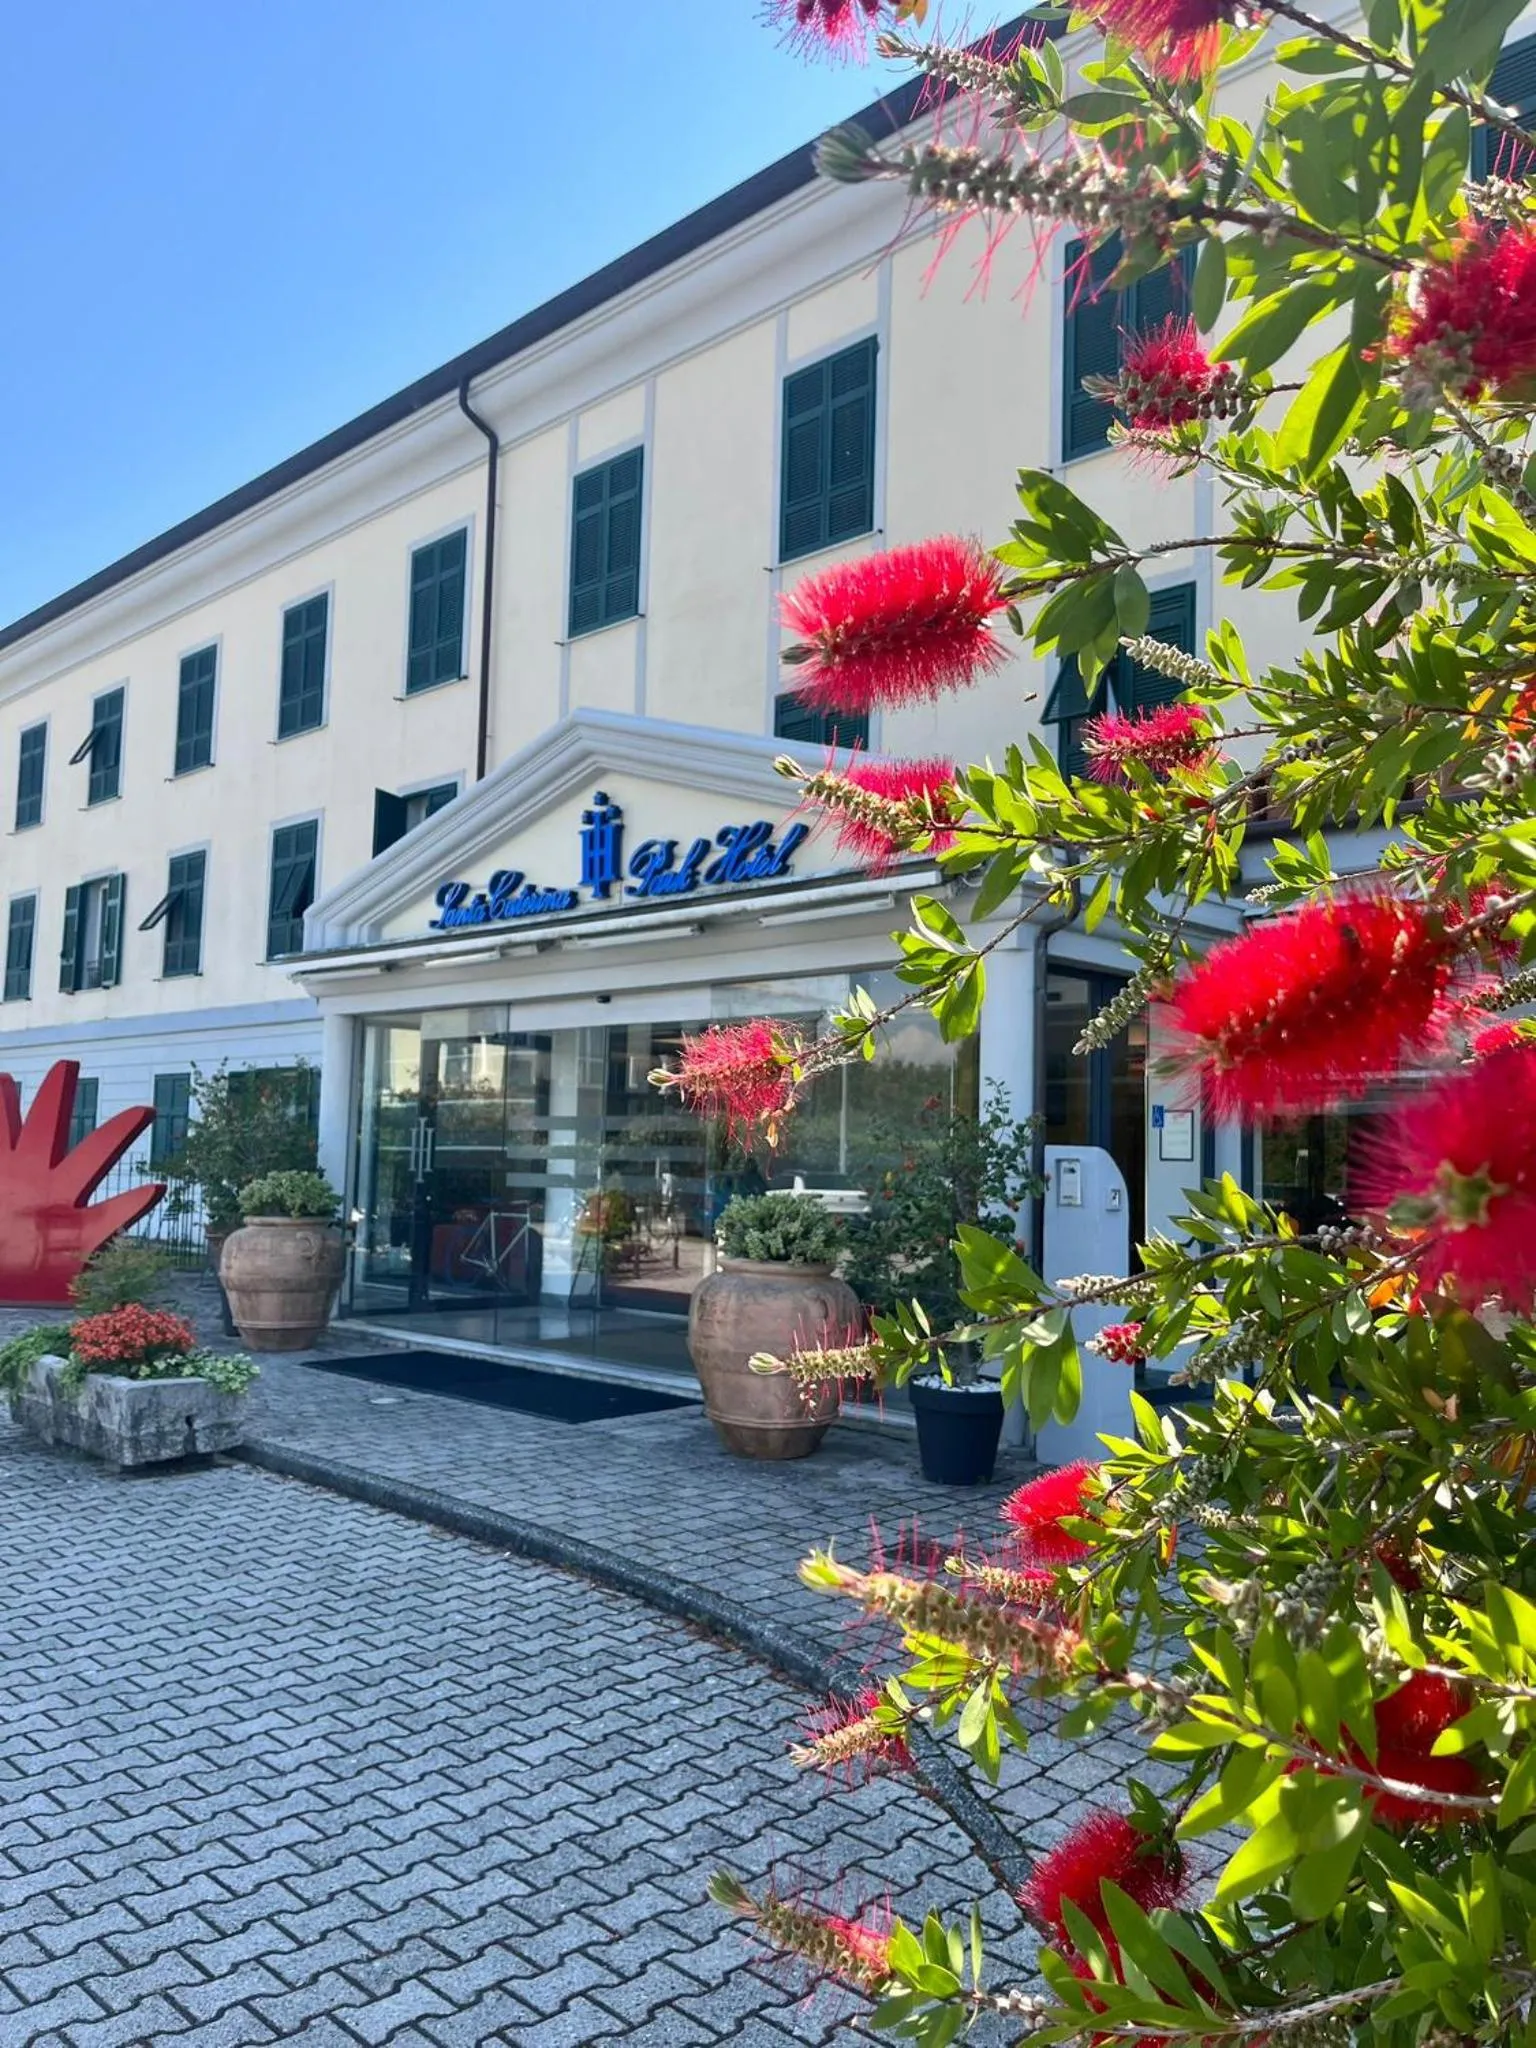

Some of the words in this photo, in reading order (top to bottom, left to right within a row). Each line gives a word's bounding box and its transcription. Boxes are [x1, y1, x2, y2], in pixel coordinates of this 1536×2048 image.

[429, 882, 490, 929] Santa
[489, 869, 579, 920] Caterina
[625, 838, 711, 897] Park
[704, 820, 809, 884] Hotel
